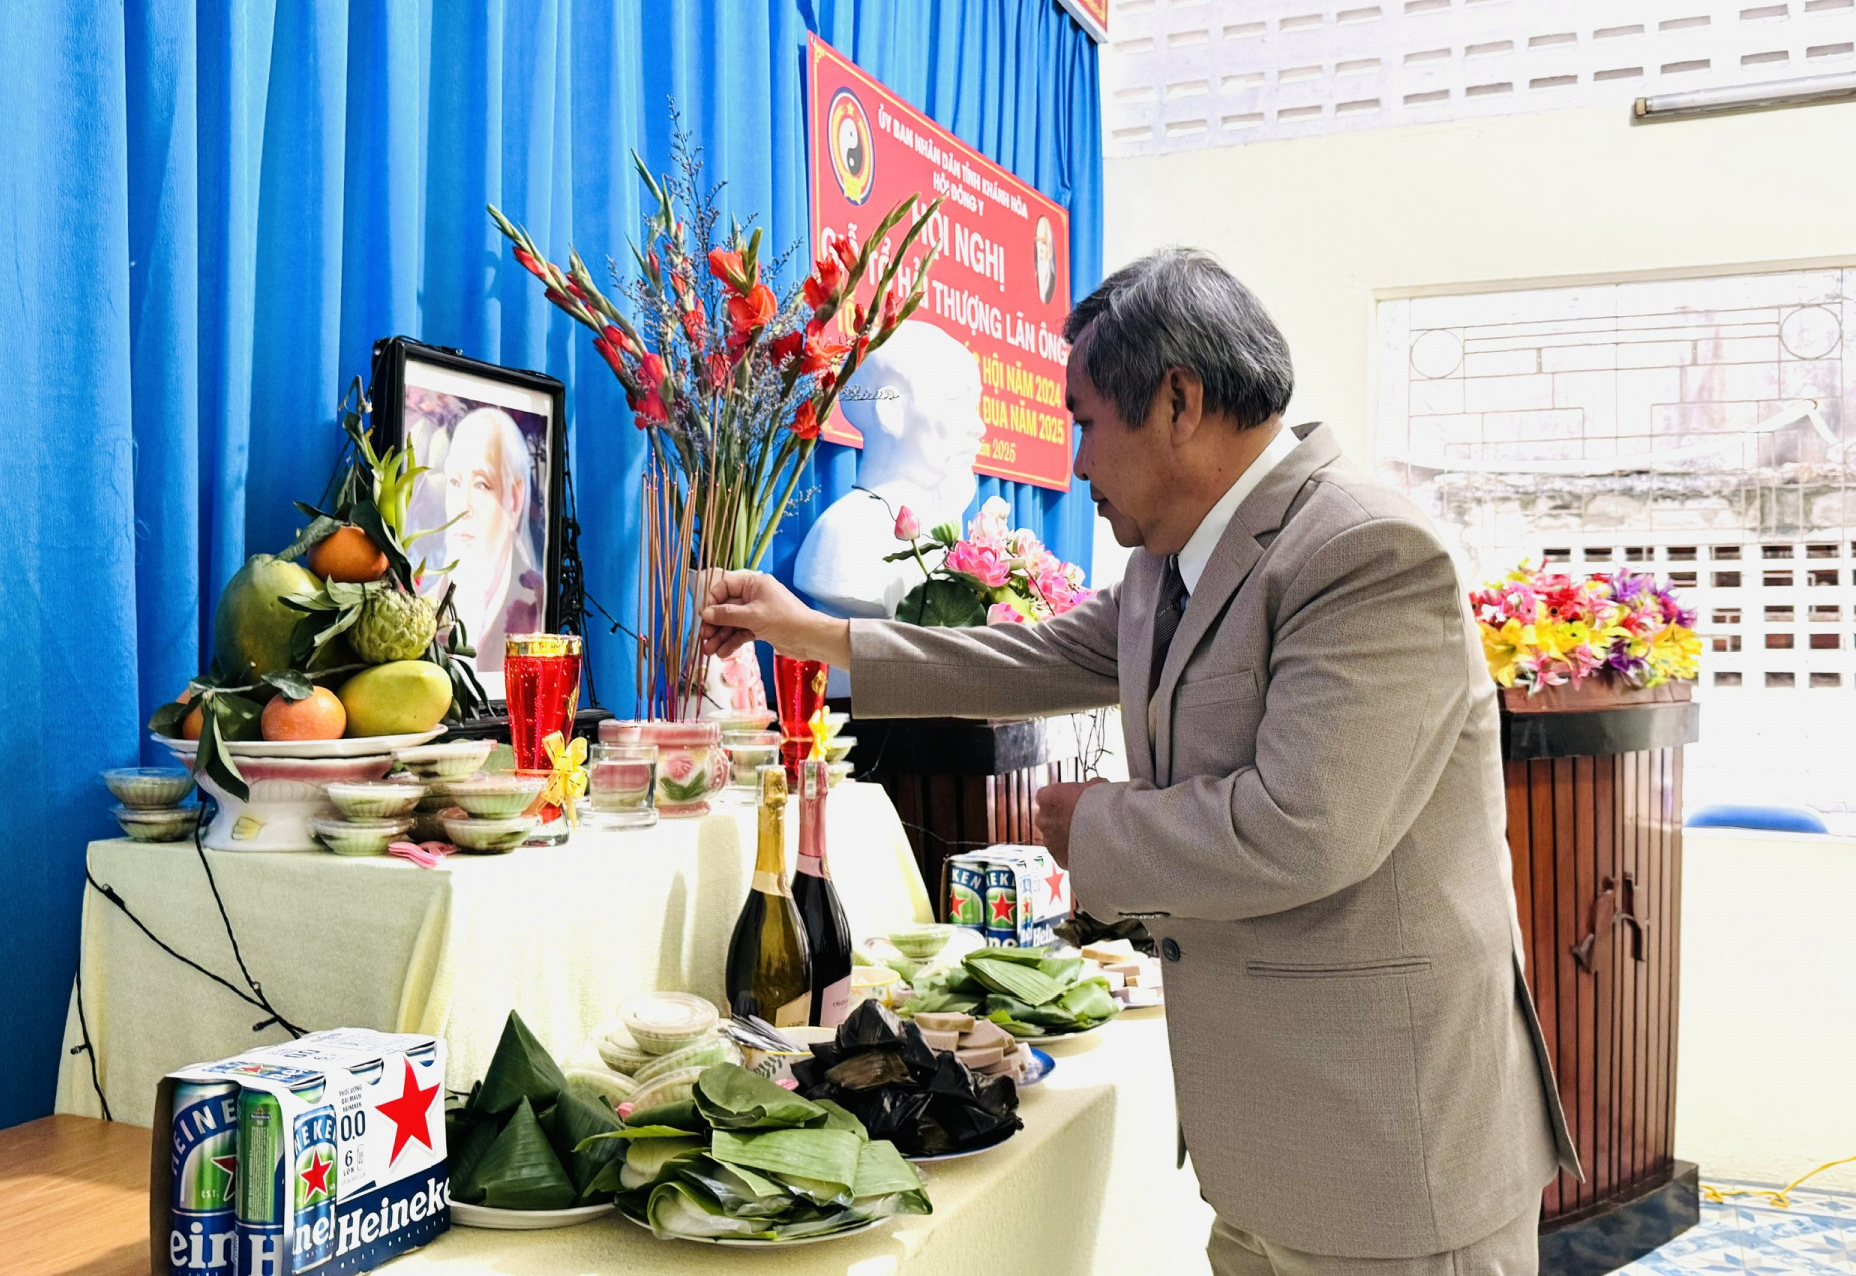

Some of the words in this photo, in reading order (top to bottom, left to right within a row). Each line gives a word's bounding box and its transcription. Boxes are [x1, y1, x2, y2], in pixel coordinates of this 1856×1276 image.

[878, 103, 892, 132] ỦY
[893, 119, 913, 148] BAN
[915, 133, 940, 165] NHÂN
[942, 152, 960, 179] DÂN
[962, 161, 980, 191] TỈNH
[982, 178, 1009, 208] KHÁNH
[1011, 195, 1028, 218] HÒA
[978, 199, 984, 216] Y
[955, 223, 1004, 292] NGHỊ
[931, 279, 1002, 340] THƯỢNG
[1006, 311, 1035, 353] LÃN
[1038, 320, 1068, 367] ÔNG
[982, 352, 1004, 394] HỘI
[1006, 360, 1034, 399] NĂM
[1035, 375, 1062, 408] 2024
[982, 395, 1008, 429] ĐUA
[1010, 400, 1037, 437] NĂM
[1039, 412, 1064, 445] 2025
[992, 438, 1016, 463] 2025
[341, 1110, 366, 1142] 0.0
[345, 1150, 353, 1167] 6
